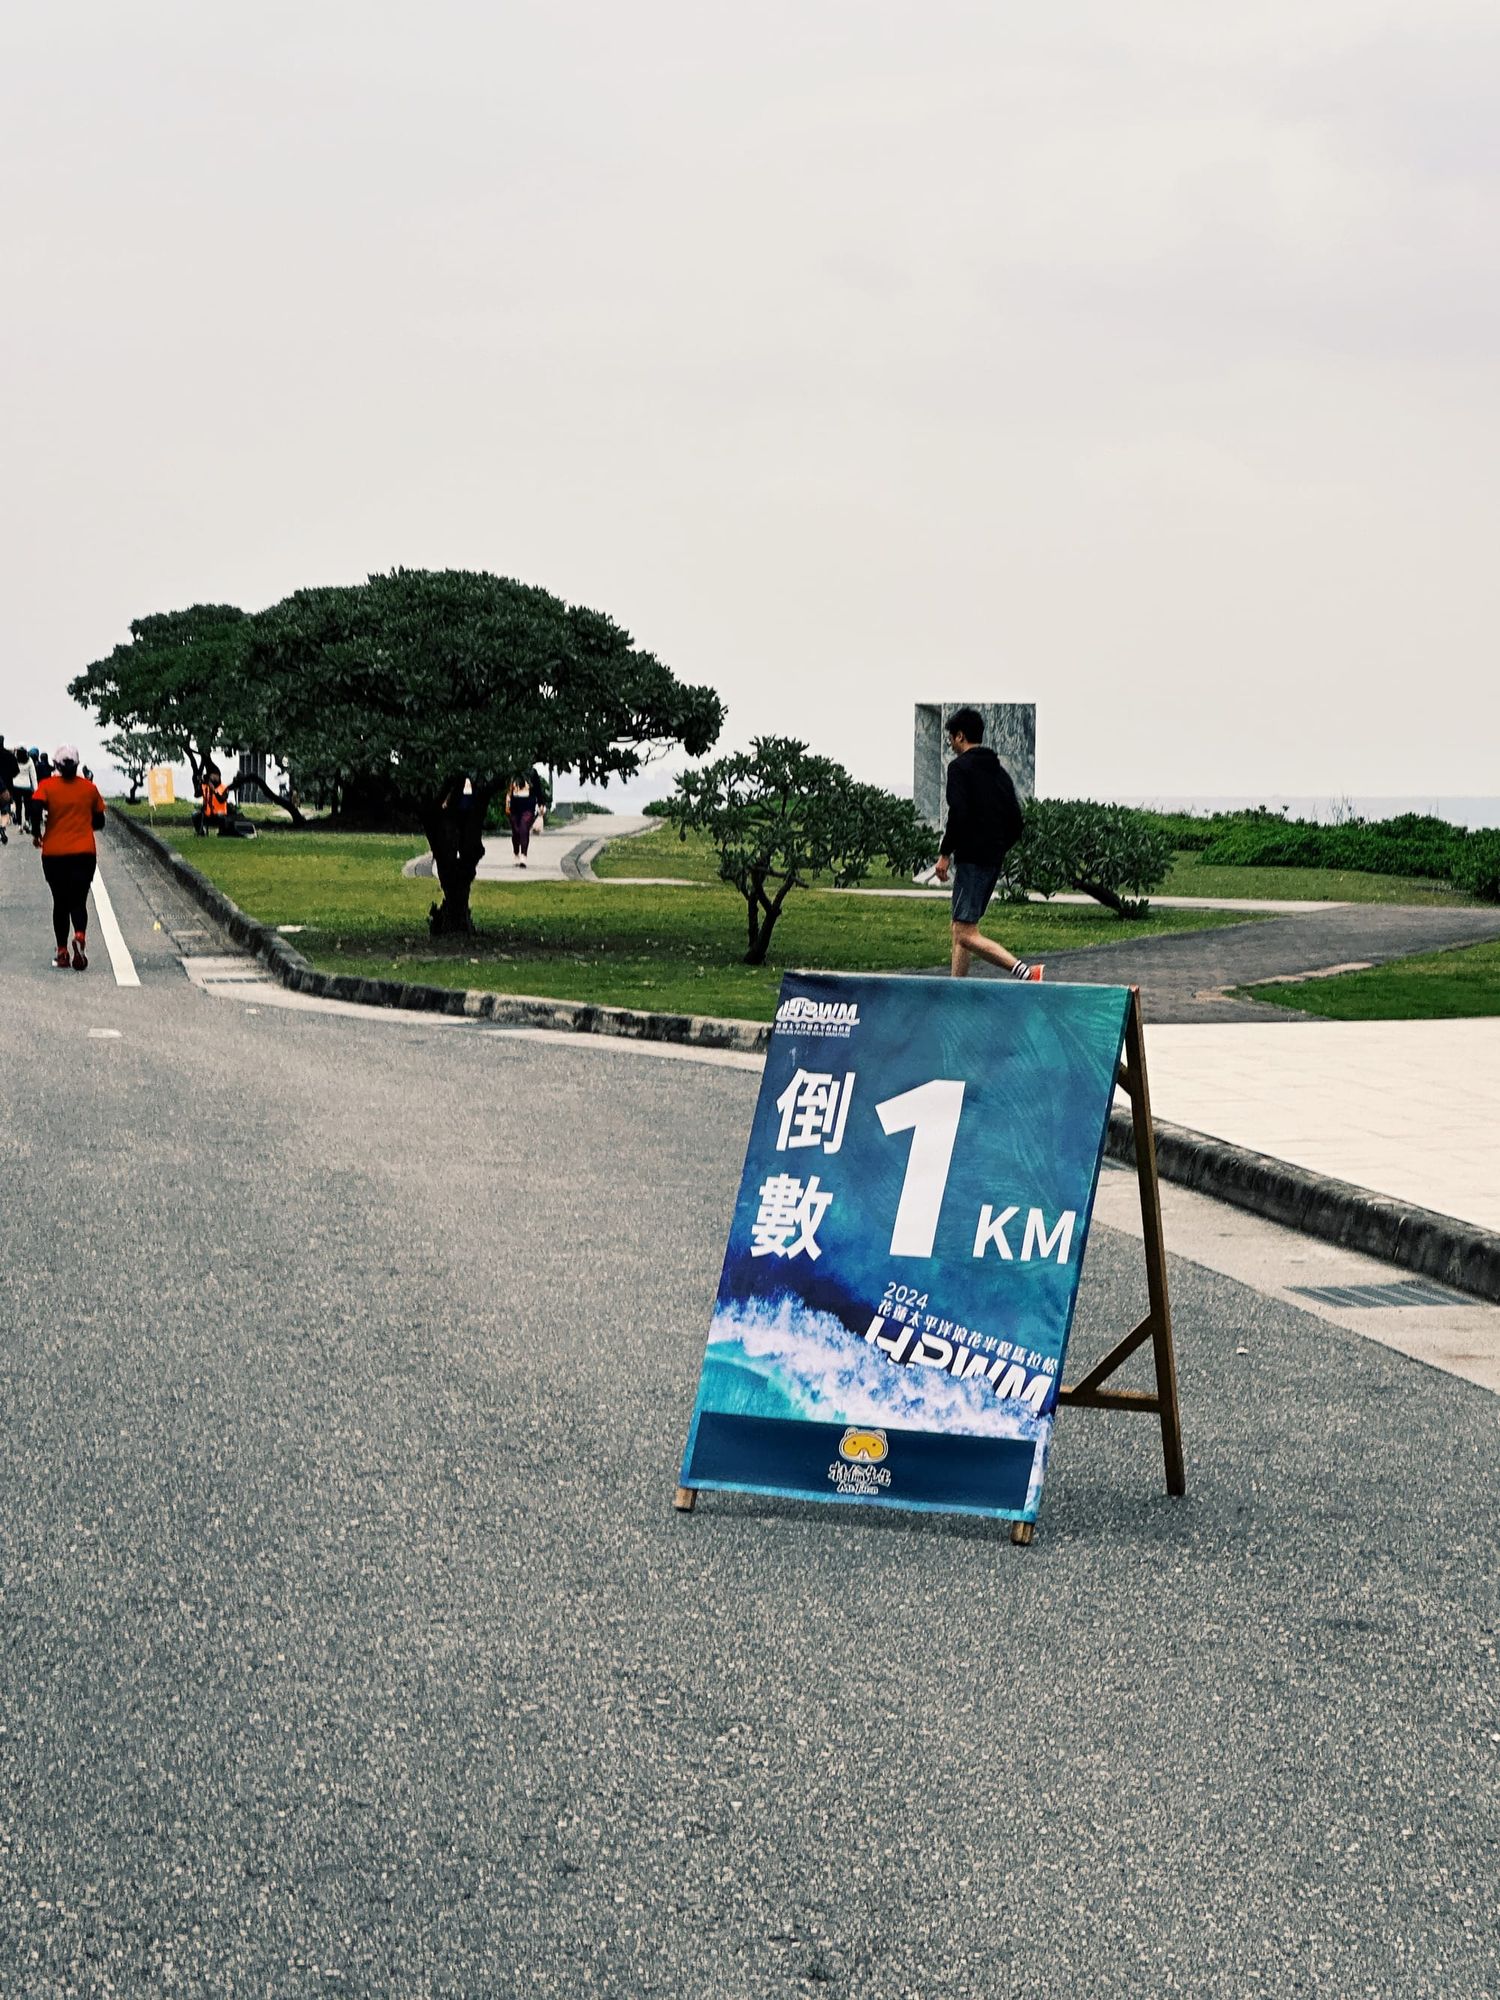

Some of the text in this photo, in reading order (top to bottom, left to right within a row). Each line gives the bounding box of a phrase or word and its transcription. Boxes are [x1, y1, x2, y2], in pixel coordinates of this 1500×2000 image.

[751, 1068, 856, 1261] 倒數
[875, 1079, 966, 1258] 1
[973, 1204, 1076, 1264] KM
[883, 1281, 928, 1310] 2024
